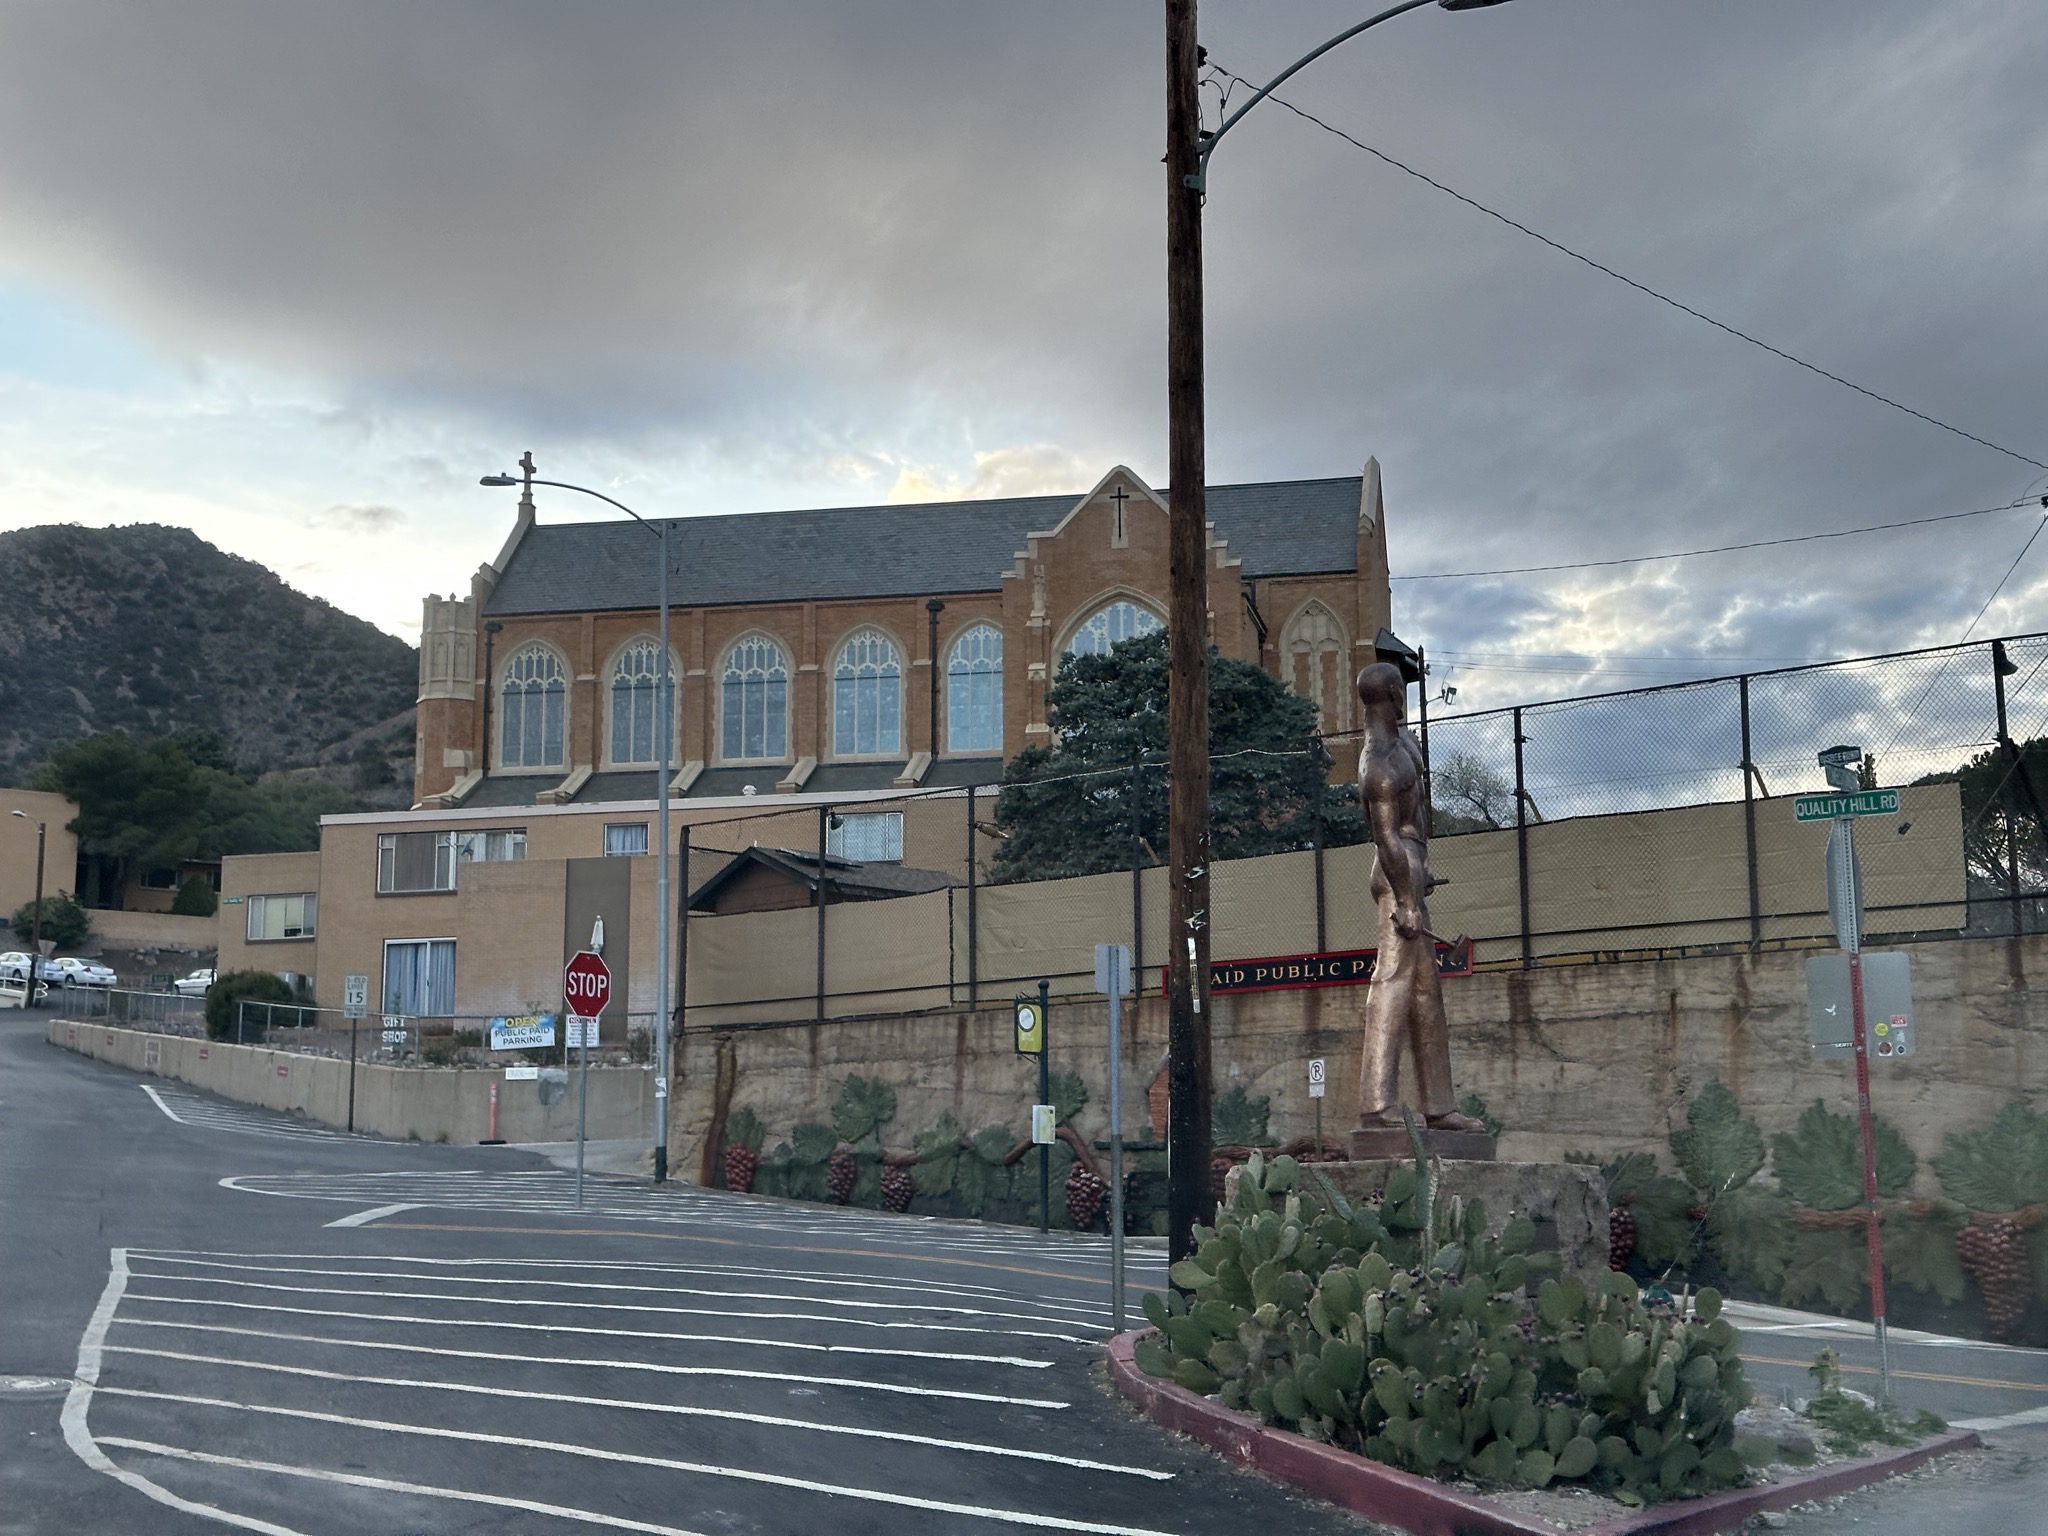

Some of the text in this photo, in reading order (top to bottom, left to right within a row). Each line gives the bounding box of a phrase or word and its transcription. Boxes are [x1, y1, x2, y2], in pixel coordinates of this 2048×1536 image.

[1796, 795, 1897, 817] QUALITY HILL RD
[1210, 970, 1245, 985] AID
[1256, 962, 1341, 981] PUBLIC
[567, 971, 607, 998] STOP
[349, 991, 364, 1004] 15
[383, 1017, 405, 1028] GIFT
[505, 1016, 539, 1028] OPEN
[381, 1031, 407, 1043] SHOP
[494, 1026, 550, 1037] PUBLIC PAID
[502, 1036, 543, 1045] PARKING
